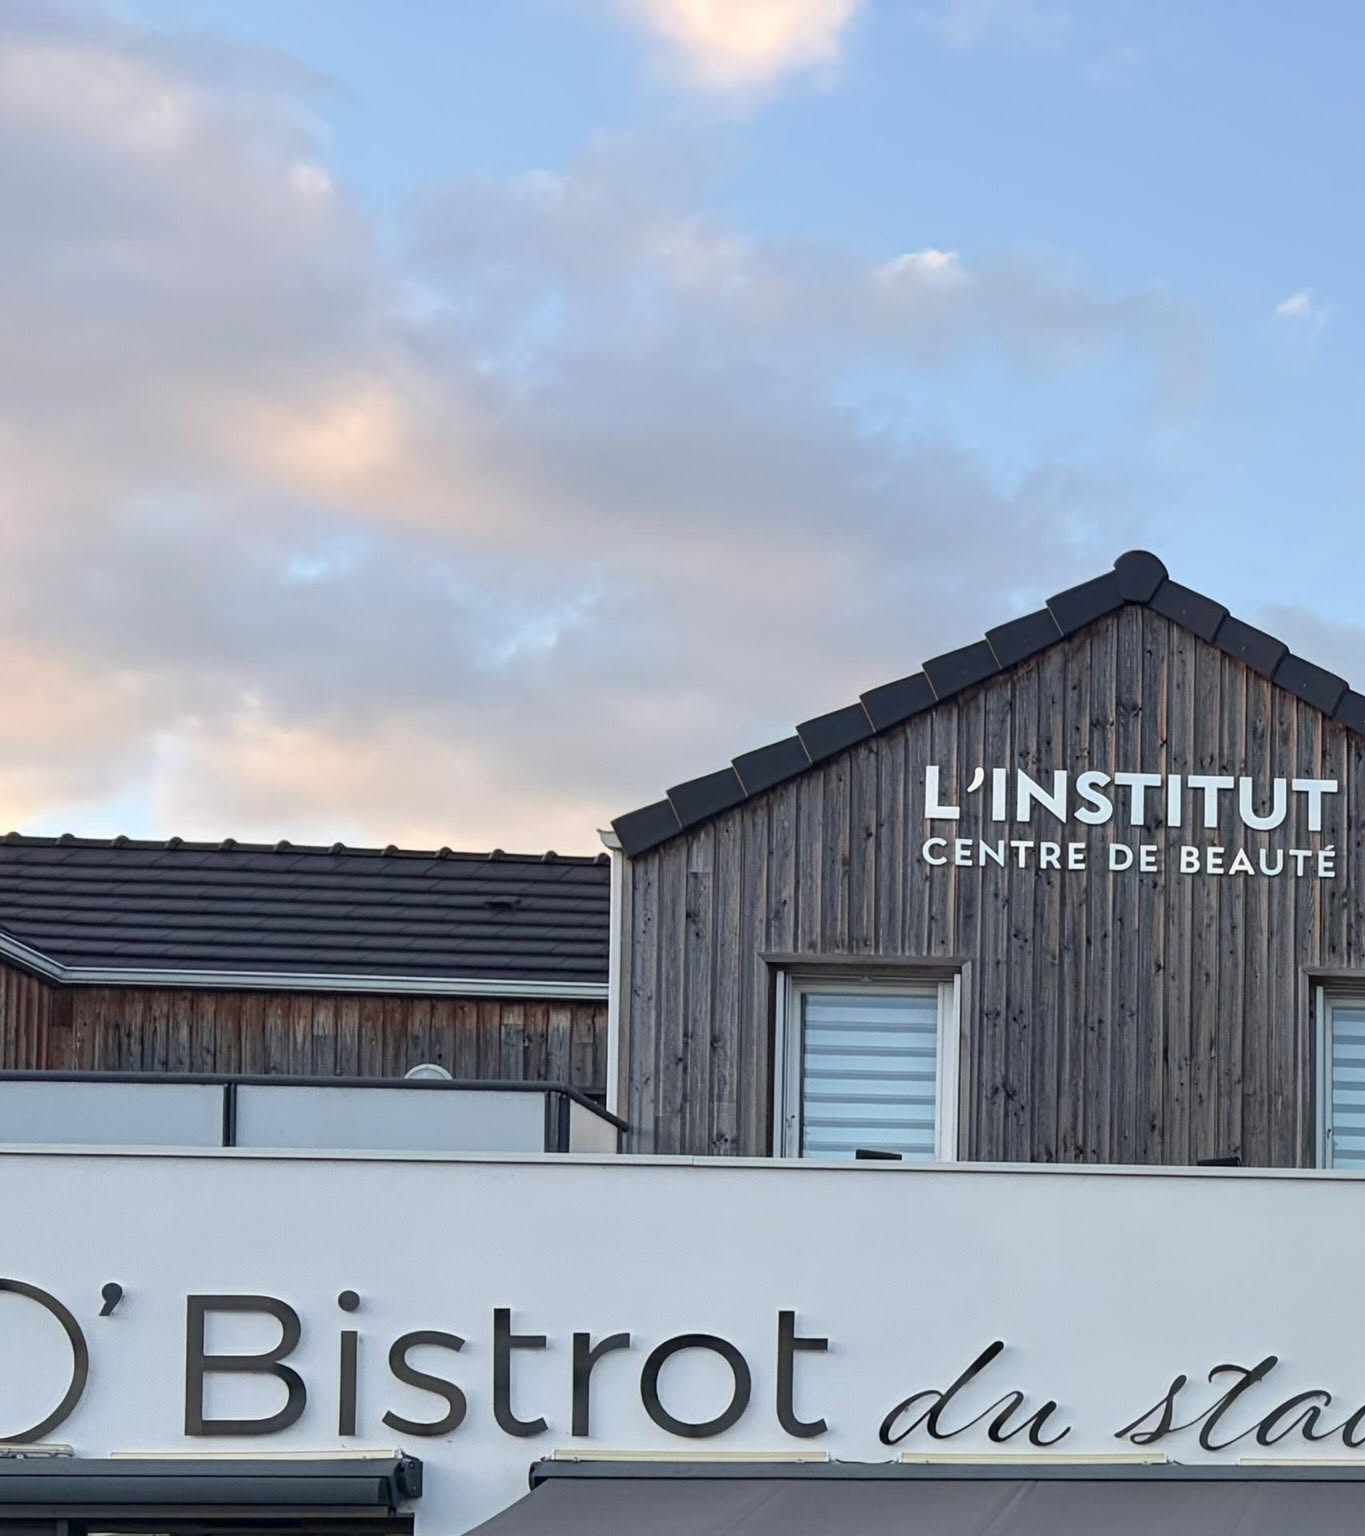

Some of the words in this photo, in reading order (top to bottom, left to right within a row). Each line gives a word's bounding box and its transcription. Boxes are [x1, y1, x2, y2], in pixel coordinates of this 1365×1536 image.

[924, 765, 1339, 832] L'INSTITUT
[922, 837, 1086, 871] CENTRE
[1109, 842, 1158, 872] DE
[1179, 843, 1337, 879] BEAUTÉ
[184, 1289, 830, 1440] Bistrot
[878, 1340, 1072, 1447] du
